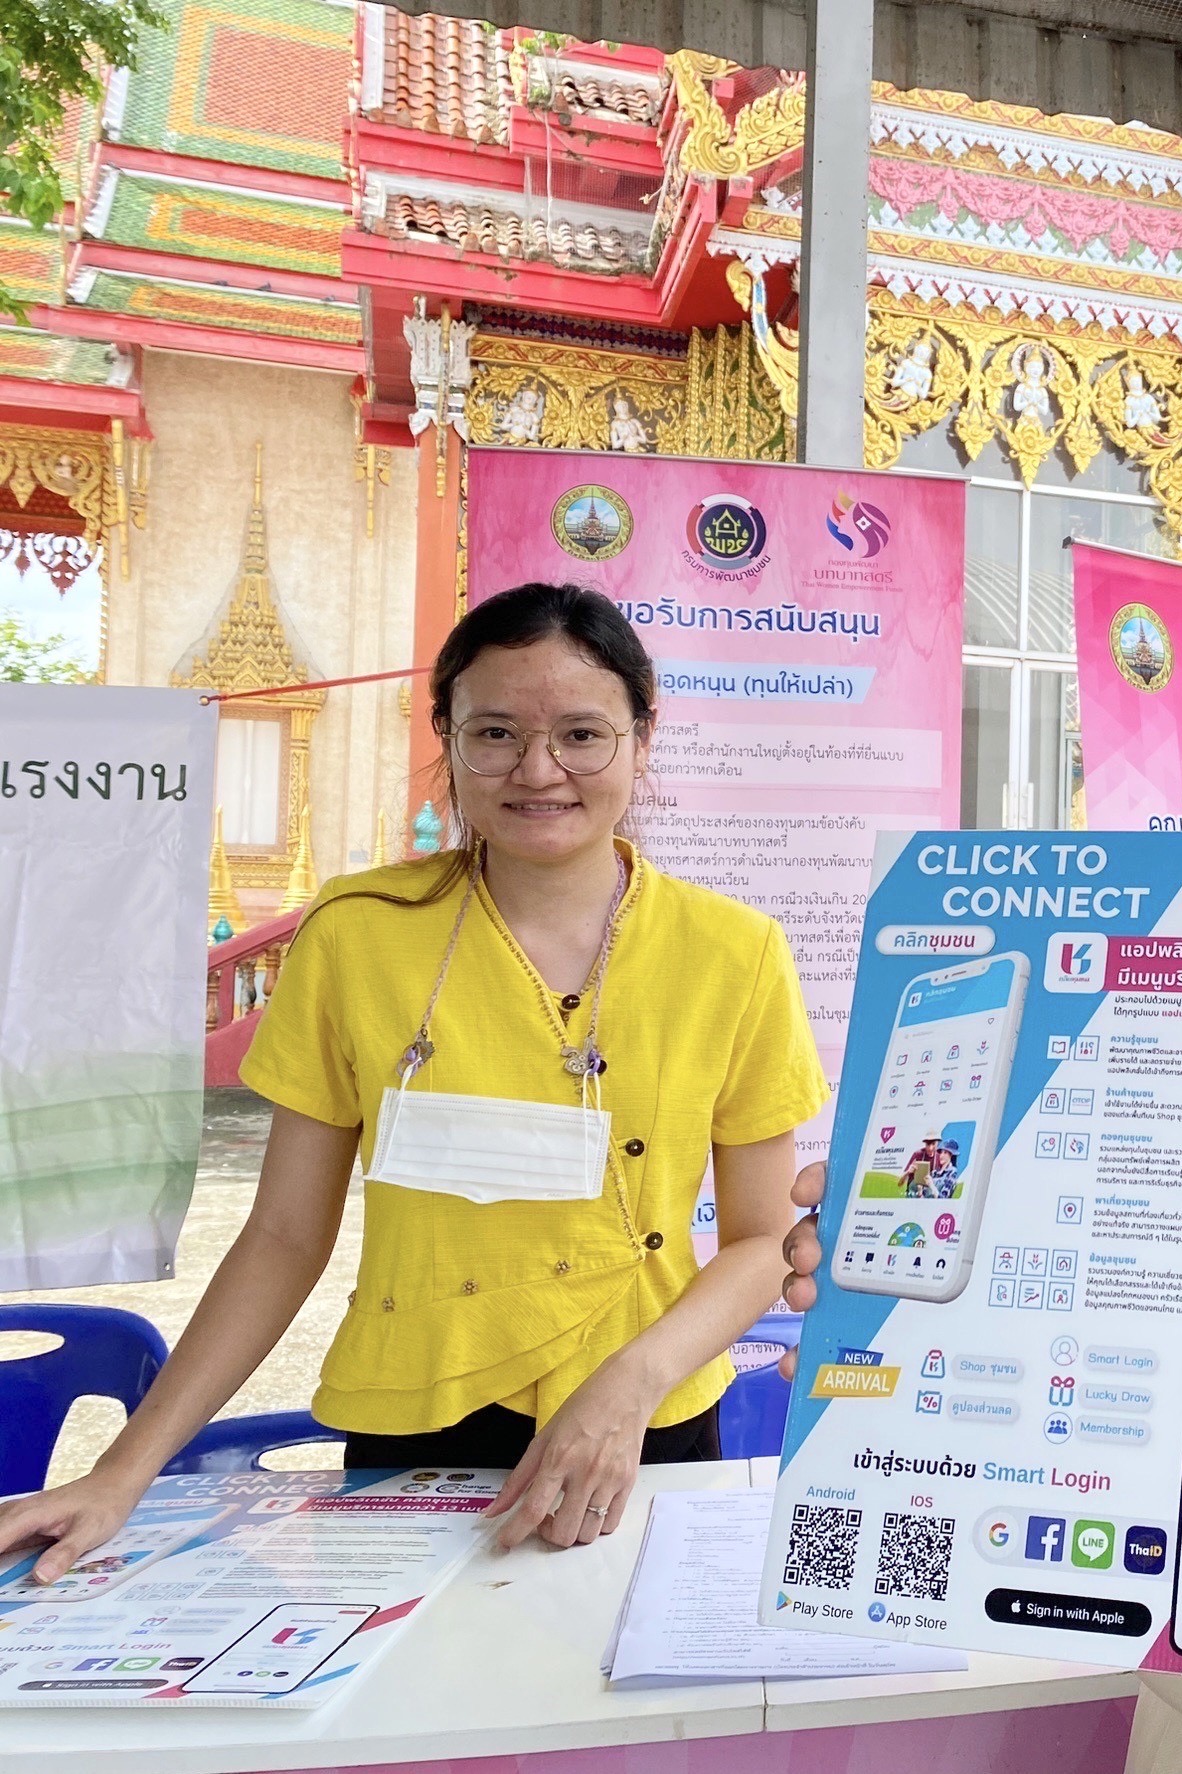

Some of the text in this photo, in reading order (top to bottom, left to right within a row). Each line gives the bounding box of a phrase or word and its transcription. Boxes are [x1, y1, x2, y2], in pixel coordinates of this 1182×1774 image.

[681, 548, 772, 583] กรมการพัฒนาชุมชน
[813, 568, 893, 584] บทบาทสตรี
[657, 670, 853, 699] อุดหนุน (ทุนให้เปล่า)
[917, 844, 1108, 876] CLICK TO
[742, 894, 766, 905] บาท
[770, 891, 848, 906] กรณีวงเงินเกิน
[942, 886, 1150, 919] CONNECT
[770, 910, 866, 924] ตรีระดับจังหวัดเ
[894, 930, 976, 951] คลิกชุมชน
[793, 946, 813, 962] อื่น
[1113, 1006, 1160, 1018] ได้ทุกรูปแบบ
[1110, 1034, 1159, 1045] ความรู้ชุมชน
[1105, 1087, 1154, 1098] ร้านค้าชุมชน
[1157, 1112, 1176, 1121] Shop
[1100, 1132, 1153, 1144] กองทุนชุมชน
[1095, 1194, 1150, 1208] พาเที่ยวชุมชน
[1089, 1252, 1137, 1266] ข้อมูลชุมชน
[844, 1352, 875, 1366] NEW
[1088, 1353, 1154, 1369] Smart Login
[960, 1359, 1017, 1377] Shop ชุมชน
[822, 1370, 891, 1393] ARRIVAL
[1085, 1388, 1151, 1404] Lucky Draw
[952, 1400, 1012, 1418] คูปองส่วนลด
[1080, 1421, 1145, 1439] Membership
[853, 1447, 1111, 1493] เข้าสู่ระบบด้วย Smart Login
[176, 1473, 328, 1487] CLICK TO
[185, 1483, 352, 1497] CONNECT
[805, 1485, 856, 1501] Android
[911, 1495, 934, 1508] IOS
[1082, 1536, 1105, 1549] LINE
[1130, 1542, 1163, 1558] ThaID
[792, 1600, 854, 1620] Play Store
[1026, 1602, 1125, 1625] Sign in with Apple
[886, 1611, 948, 1630] App Store
[58, 1643, 114, 1651] Smart
[118, 1642, 172, 1651] Login
